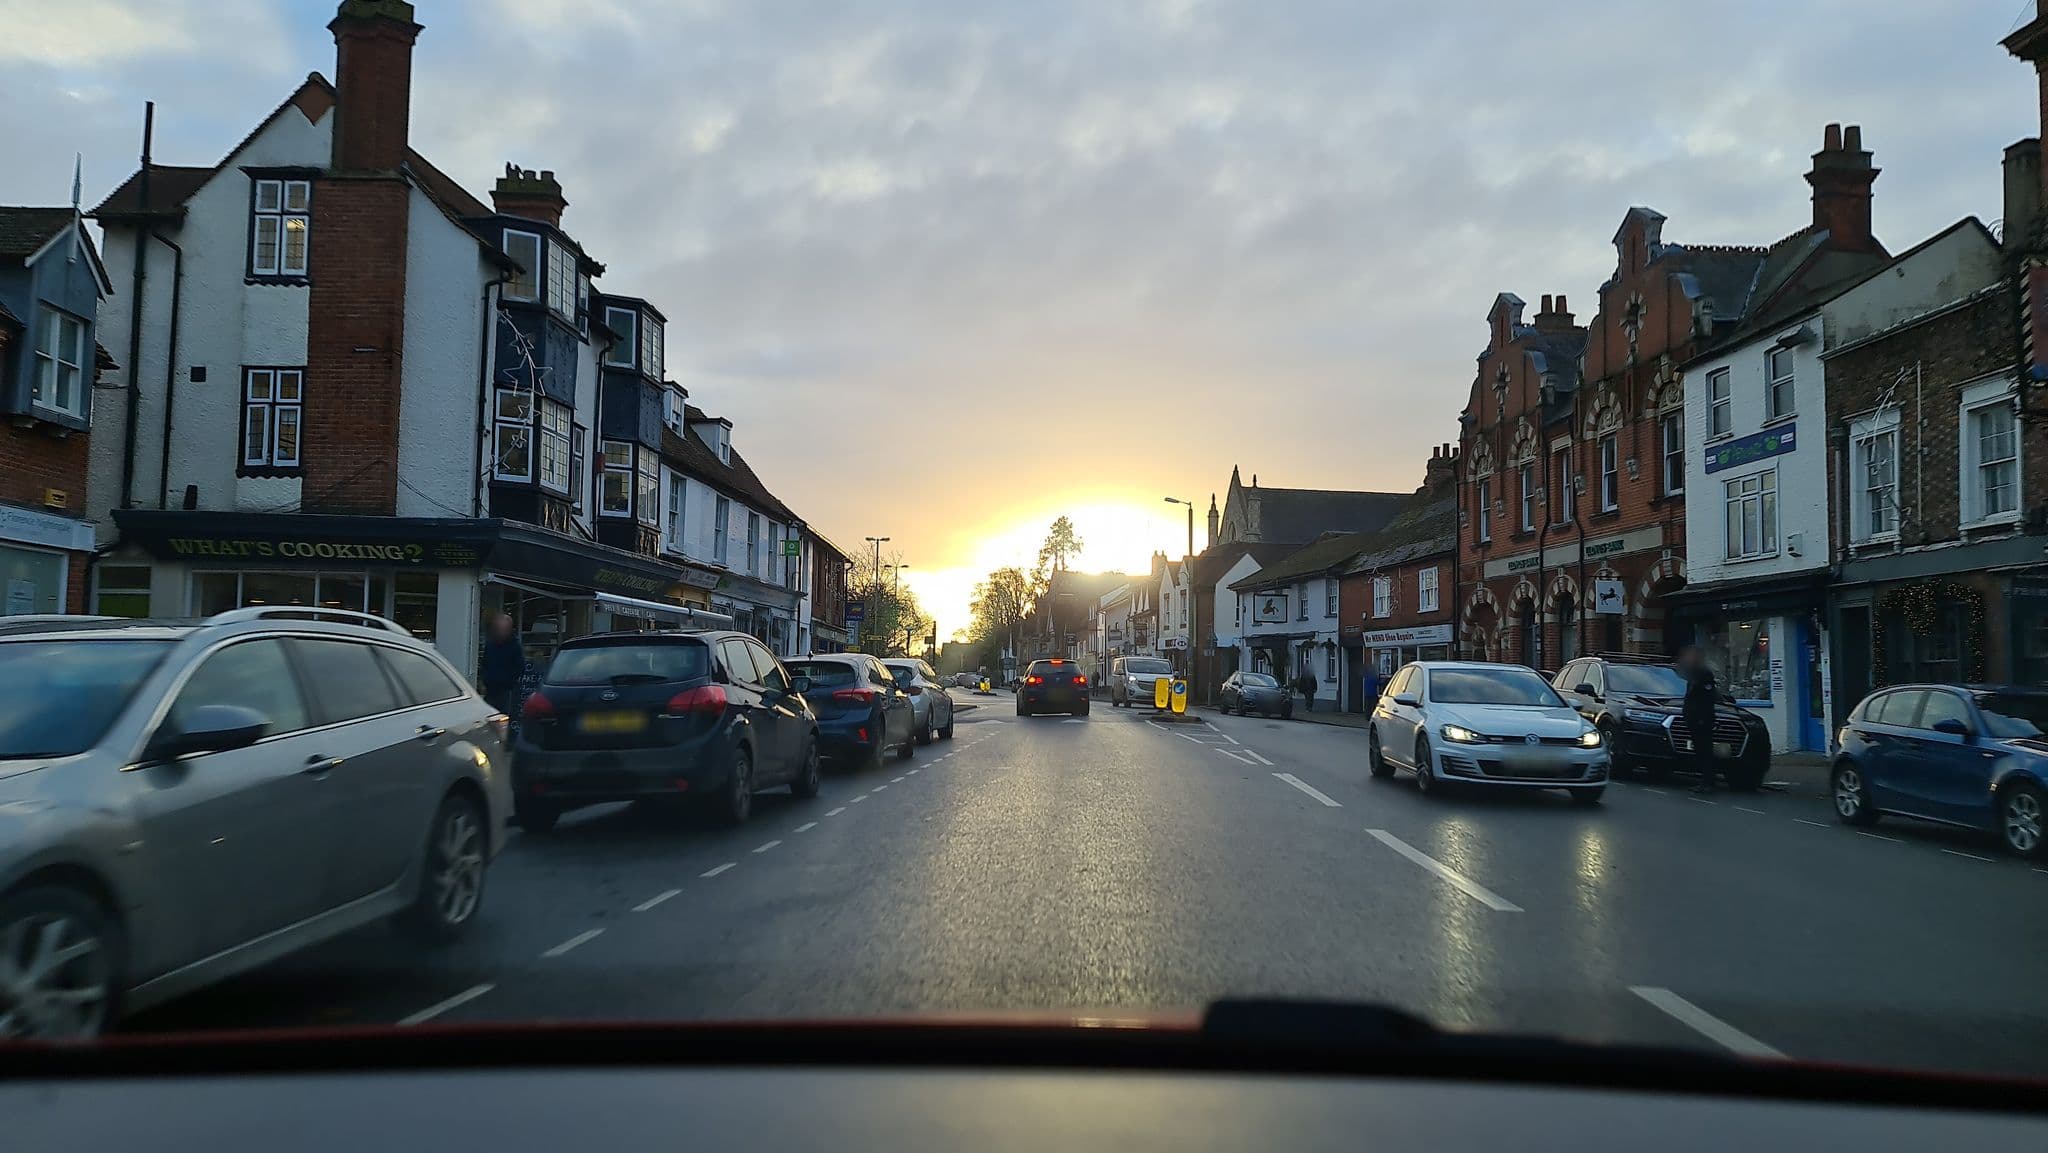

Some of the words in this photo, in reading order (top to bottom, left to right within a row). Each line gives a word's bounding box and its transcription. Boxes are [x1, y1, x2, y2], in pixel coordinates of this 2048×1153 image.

[168, 537, 273, 557] WHAT'S
[278, 541, 424, 563] COOKING?
[1396, 631, 1415, 642] Repairs
